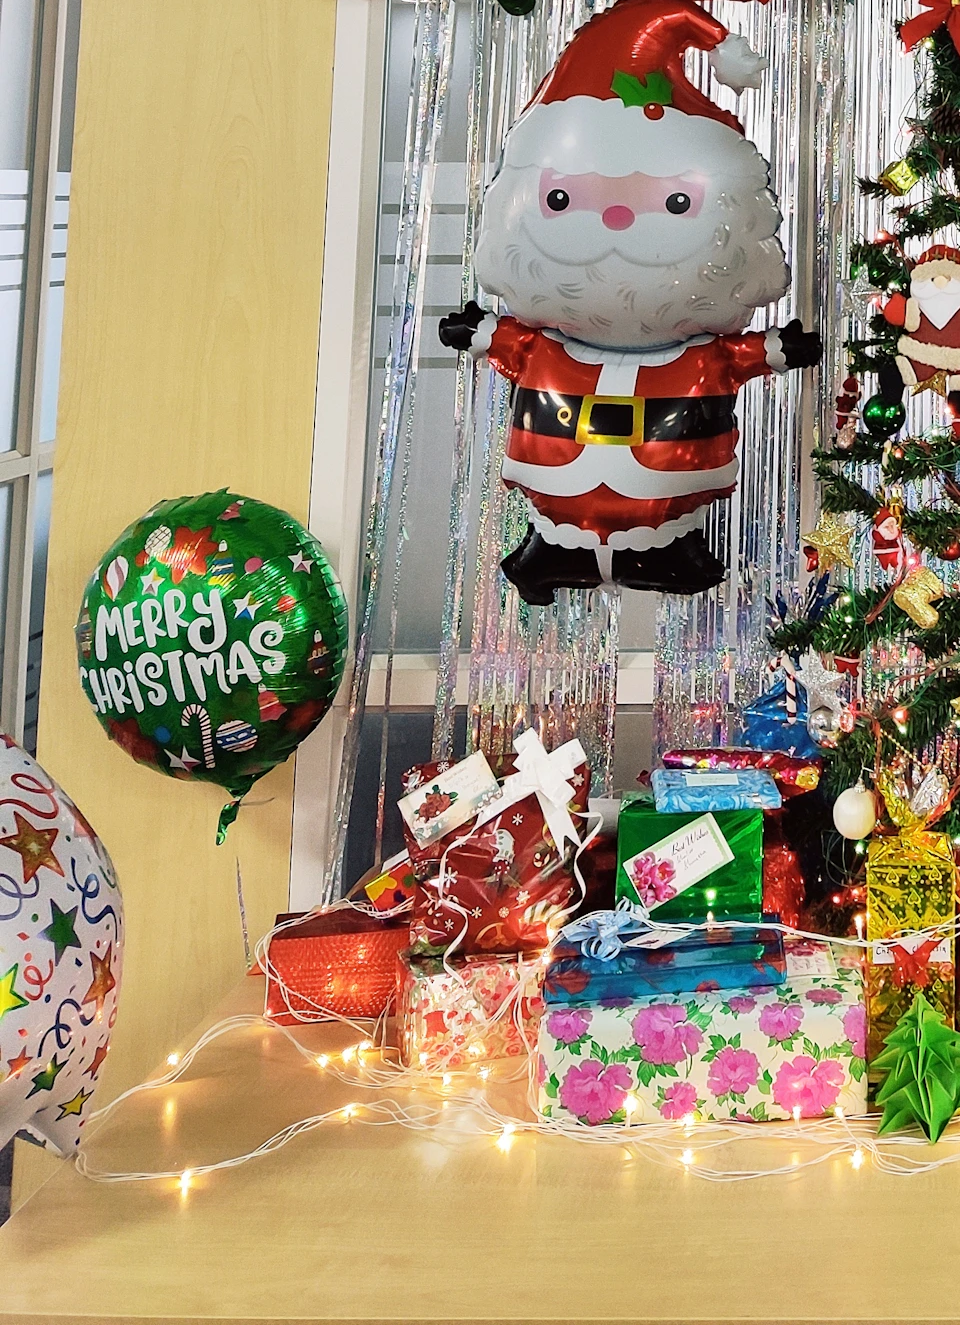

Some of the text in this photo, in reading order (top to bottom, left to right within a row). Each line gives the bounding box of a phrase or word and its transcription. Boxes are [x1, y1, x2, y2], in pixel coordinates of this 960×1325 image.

[95, 588, 227, 661] MERRY
[672, 842, 685, 856] Best
[685, 828, 709, 846] Wishes
